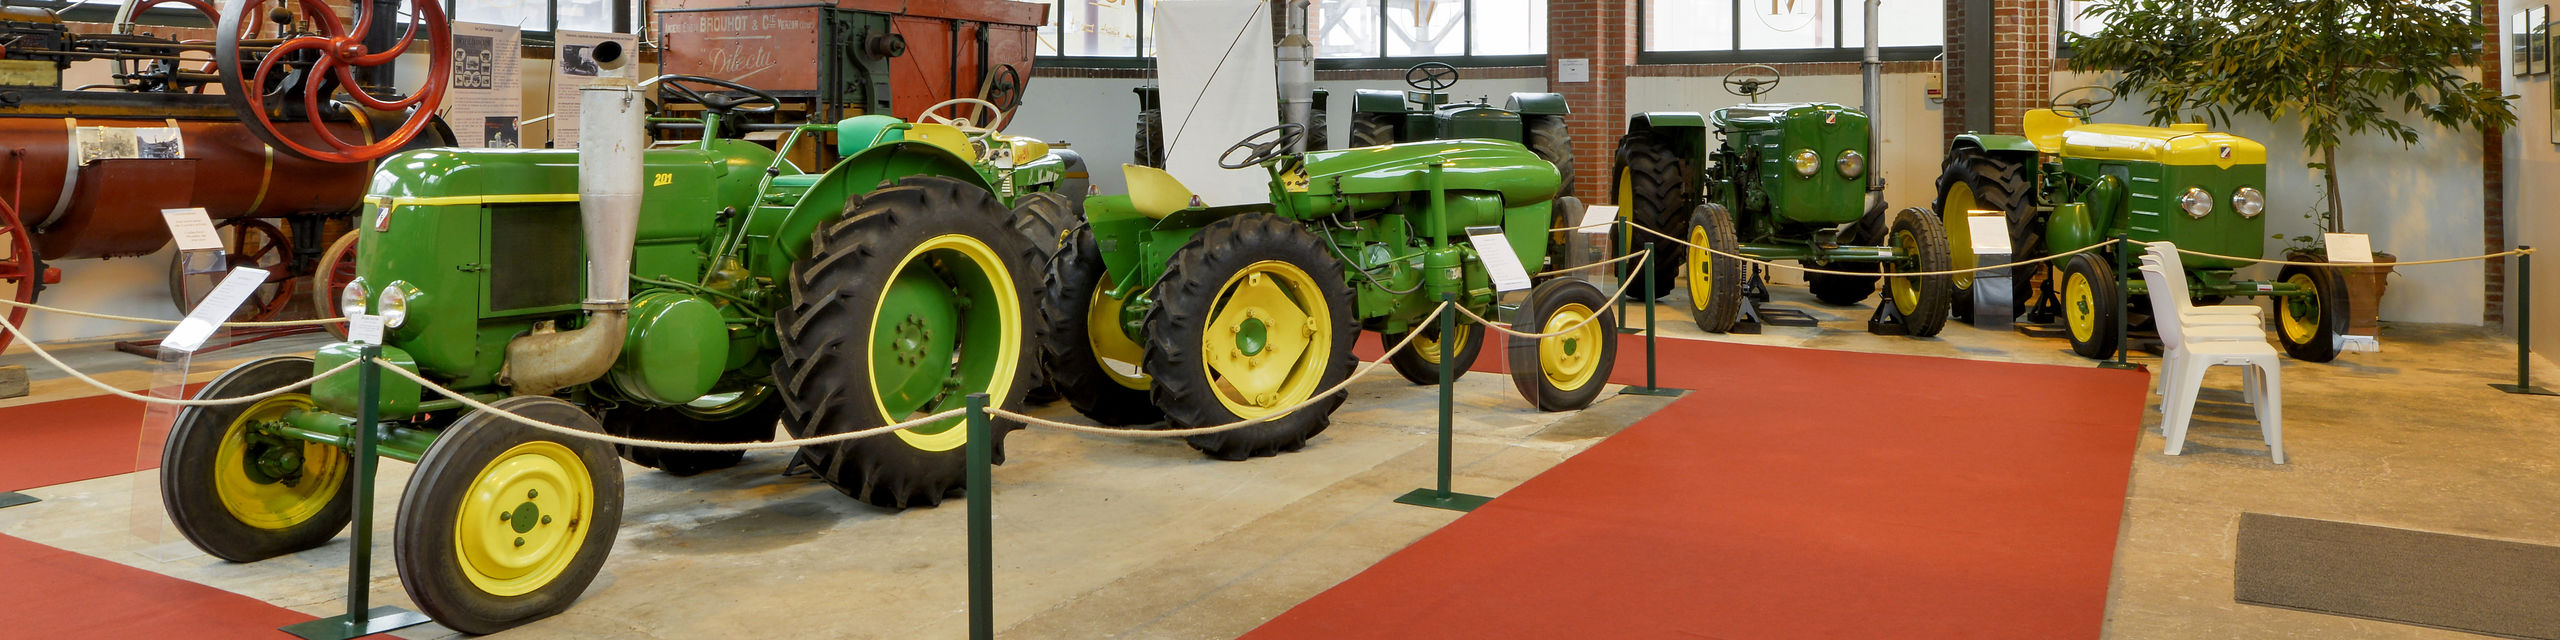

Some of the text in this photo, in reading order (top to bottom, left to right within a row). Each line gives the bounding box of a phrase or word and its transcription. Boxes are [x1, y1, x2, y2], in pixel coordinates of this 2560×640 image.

[700, 15, 748, 32] BROUHOT
[752, 19, 759, 31] &
[654, 173, 673, 187] 201
